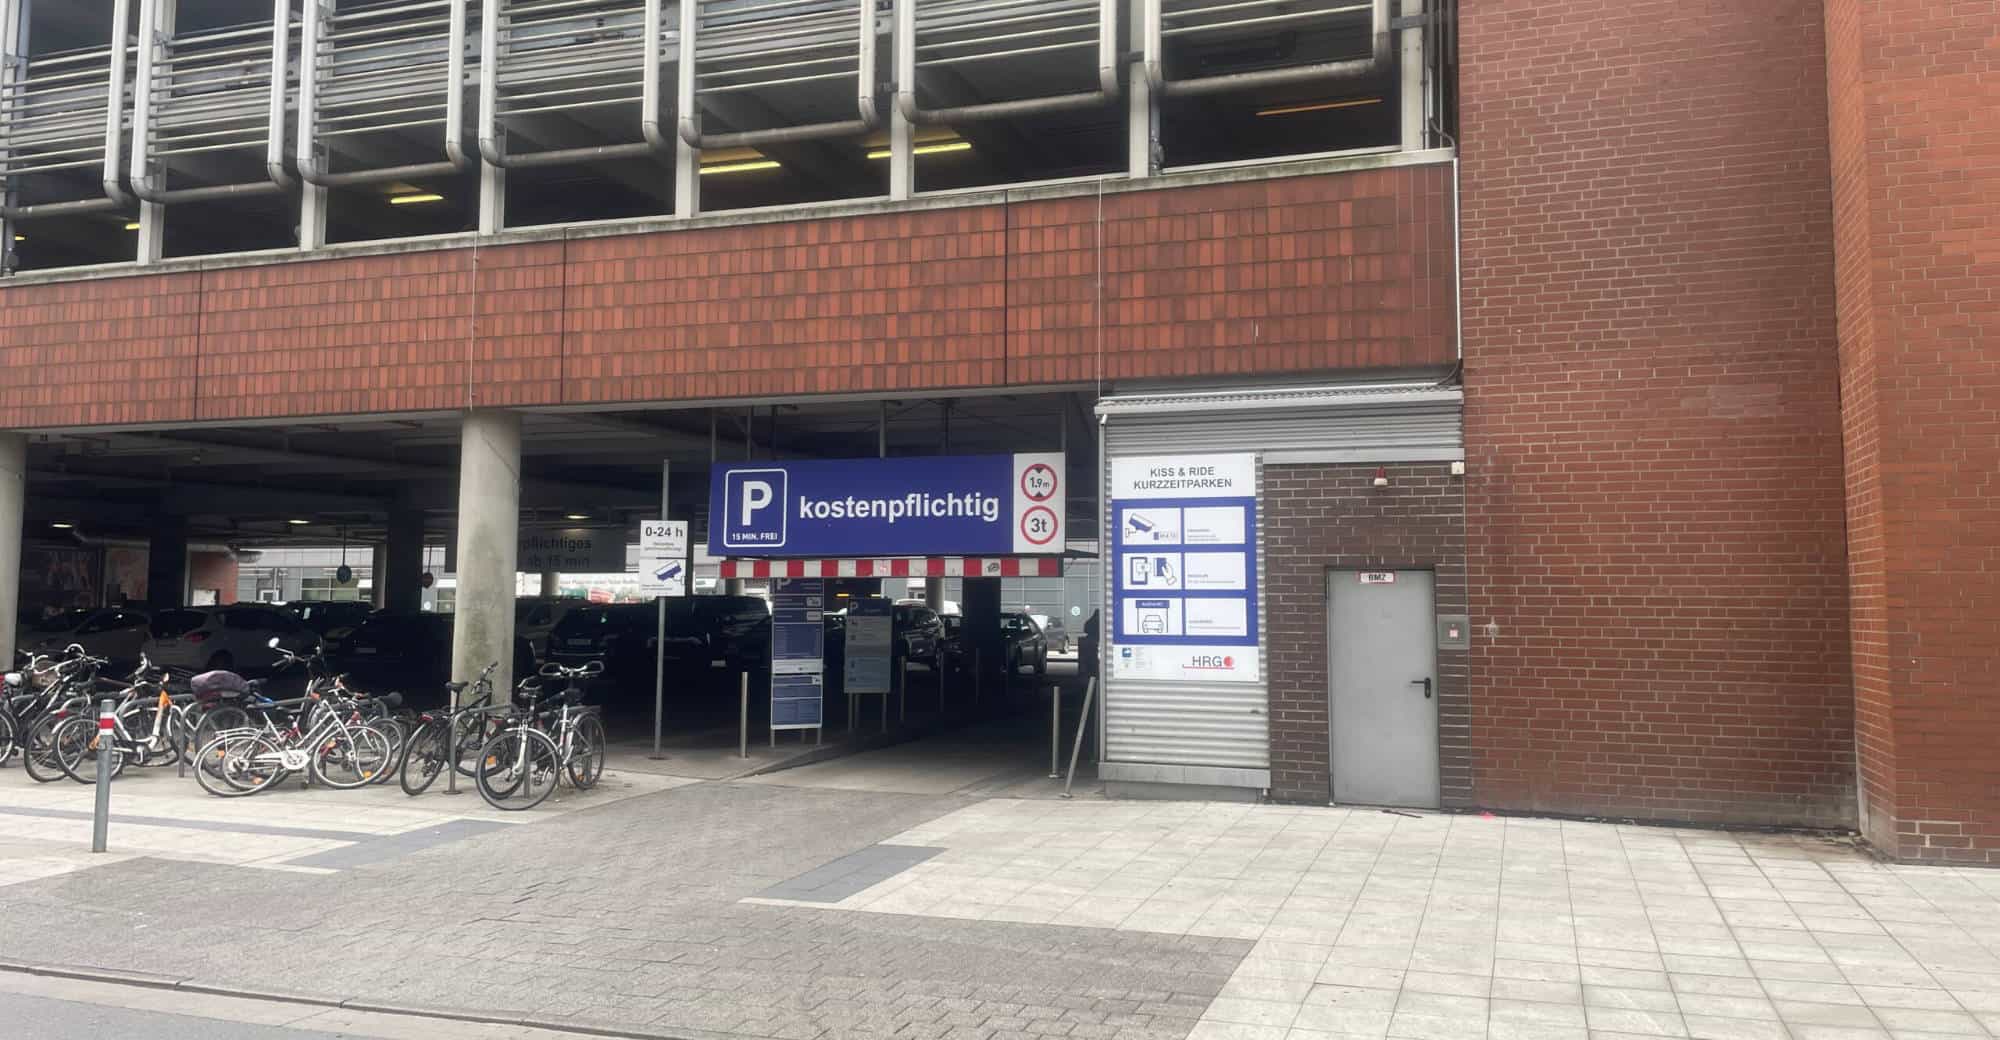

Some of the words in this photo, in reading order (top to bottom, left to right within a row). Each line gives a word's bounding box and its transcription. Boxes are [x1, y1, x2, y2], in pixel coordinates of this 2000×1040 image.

[1150, 467, 1175, 477] KISS
[1178, 467, 1186, 477] &
[1189, 466, 1215, 476] RIDE
[1133, 478, 1232, 490] KURZZEITPARKEN
[742, 480, 773, 526] P
[799, 491, 1000, 523] kostenpflichtig
[645, 526, 672, 537] 0-24
[675, 527, 683, 537] h
[731, 532, 741, 541] 15
[742, 532, 759, 541] MIN.
[760, 532, 778, 540] FREI
[1192, 656, 1223, 667] HRG
